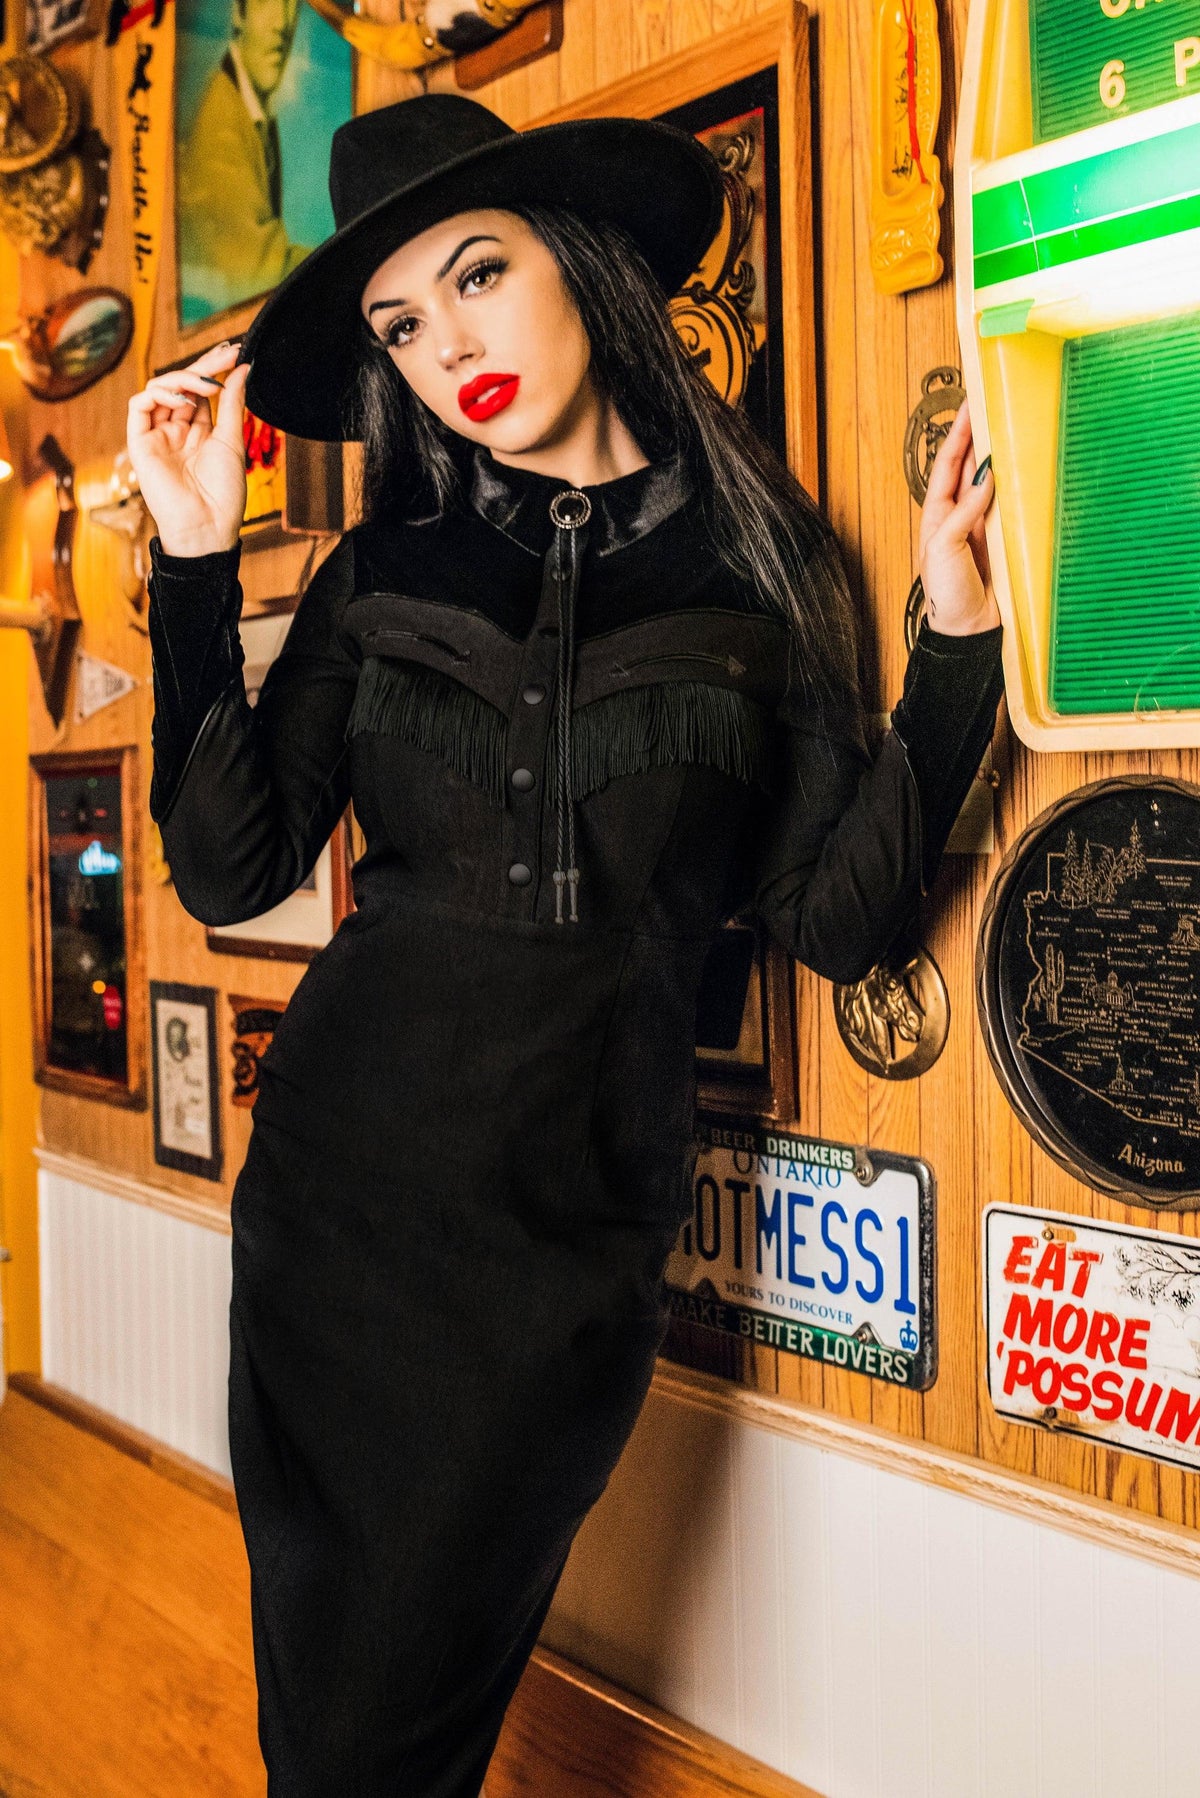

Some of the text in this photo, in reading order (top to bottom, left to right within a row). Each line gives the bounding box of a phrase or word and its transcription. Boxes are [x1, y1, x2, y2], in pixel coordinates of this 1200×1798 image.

[1099, 59, 1126, 109] 6
[766, 1137, 855, 1170] DRINKERS
[1118, 1143, 1186, 1177] Arizona
[681, 1173, 917, 1316] OTMESS1
[1002, 1235, 1104, 1299] EAT
[725, 1281, 854, 1326] YOURS TO DISCOVER
[1002, 1291, 1151, 1371] MORE
[740, 1310, 815, 1357] BETTER
[821, 1333, 909, 1384] LOVERS
